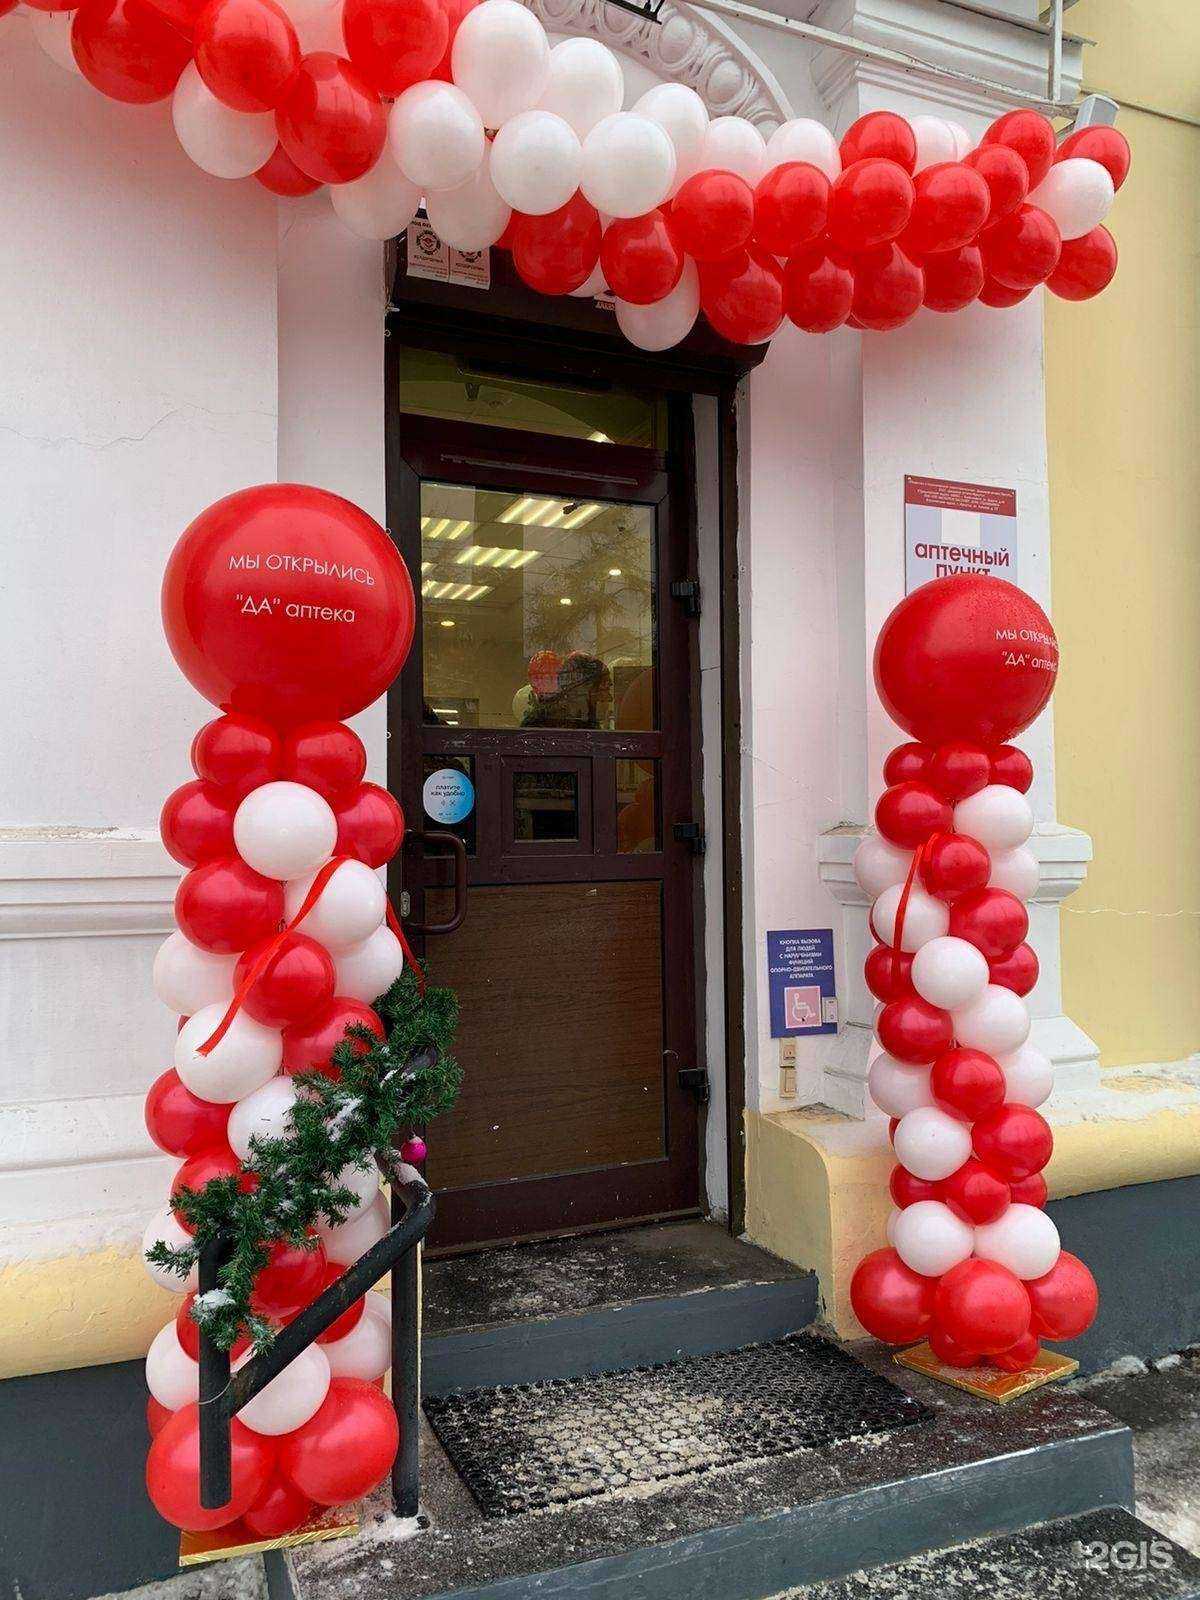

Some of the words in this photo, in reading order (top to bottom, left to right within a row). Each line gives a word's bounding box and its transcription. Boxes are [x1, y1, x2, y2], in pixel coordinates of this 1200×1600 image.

[914, 542, 1010, 567] аптечный
[229, 555, 260, 570] МЫ
[266, 554, 375, 586] ОТКРЫЛИСЬ
[236, 594, 281, 616] "ДА"
[285, 603, 356, 623] аптека
[996, 629, 1018, 641] МЫ
